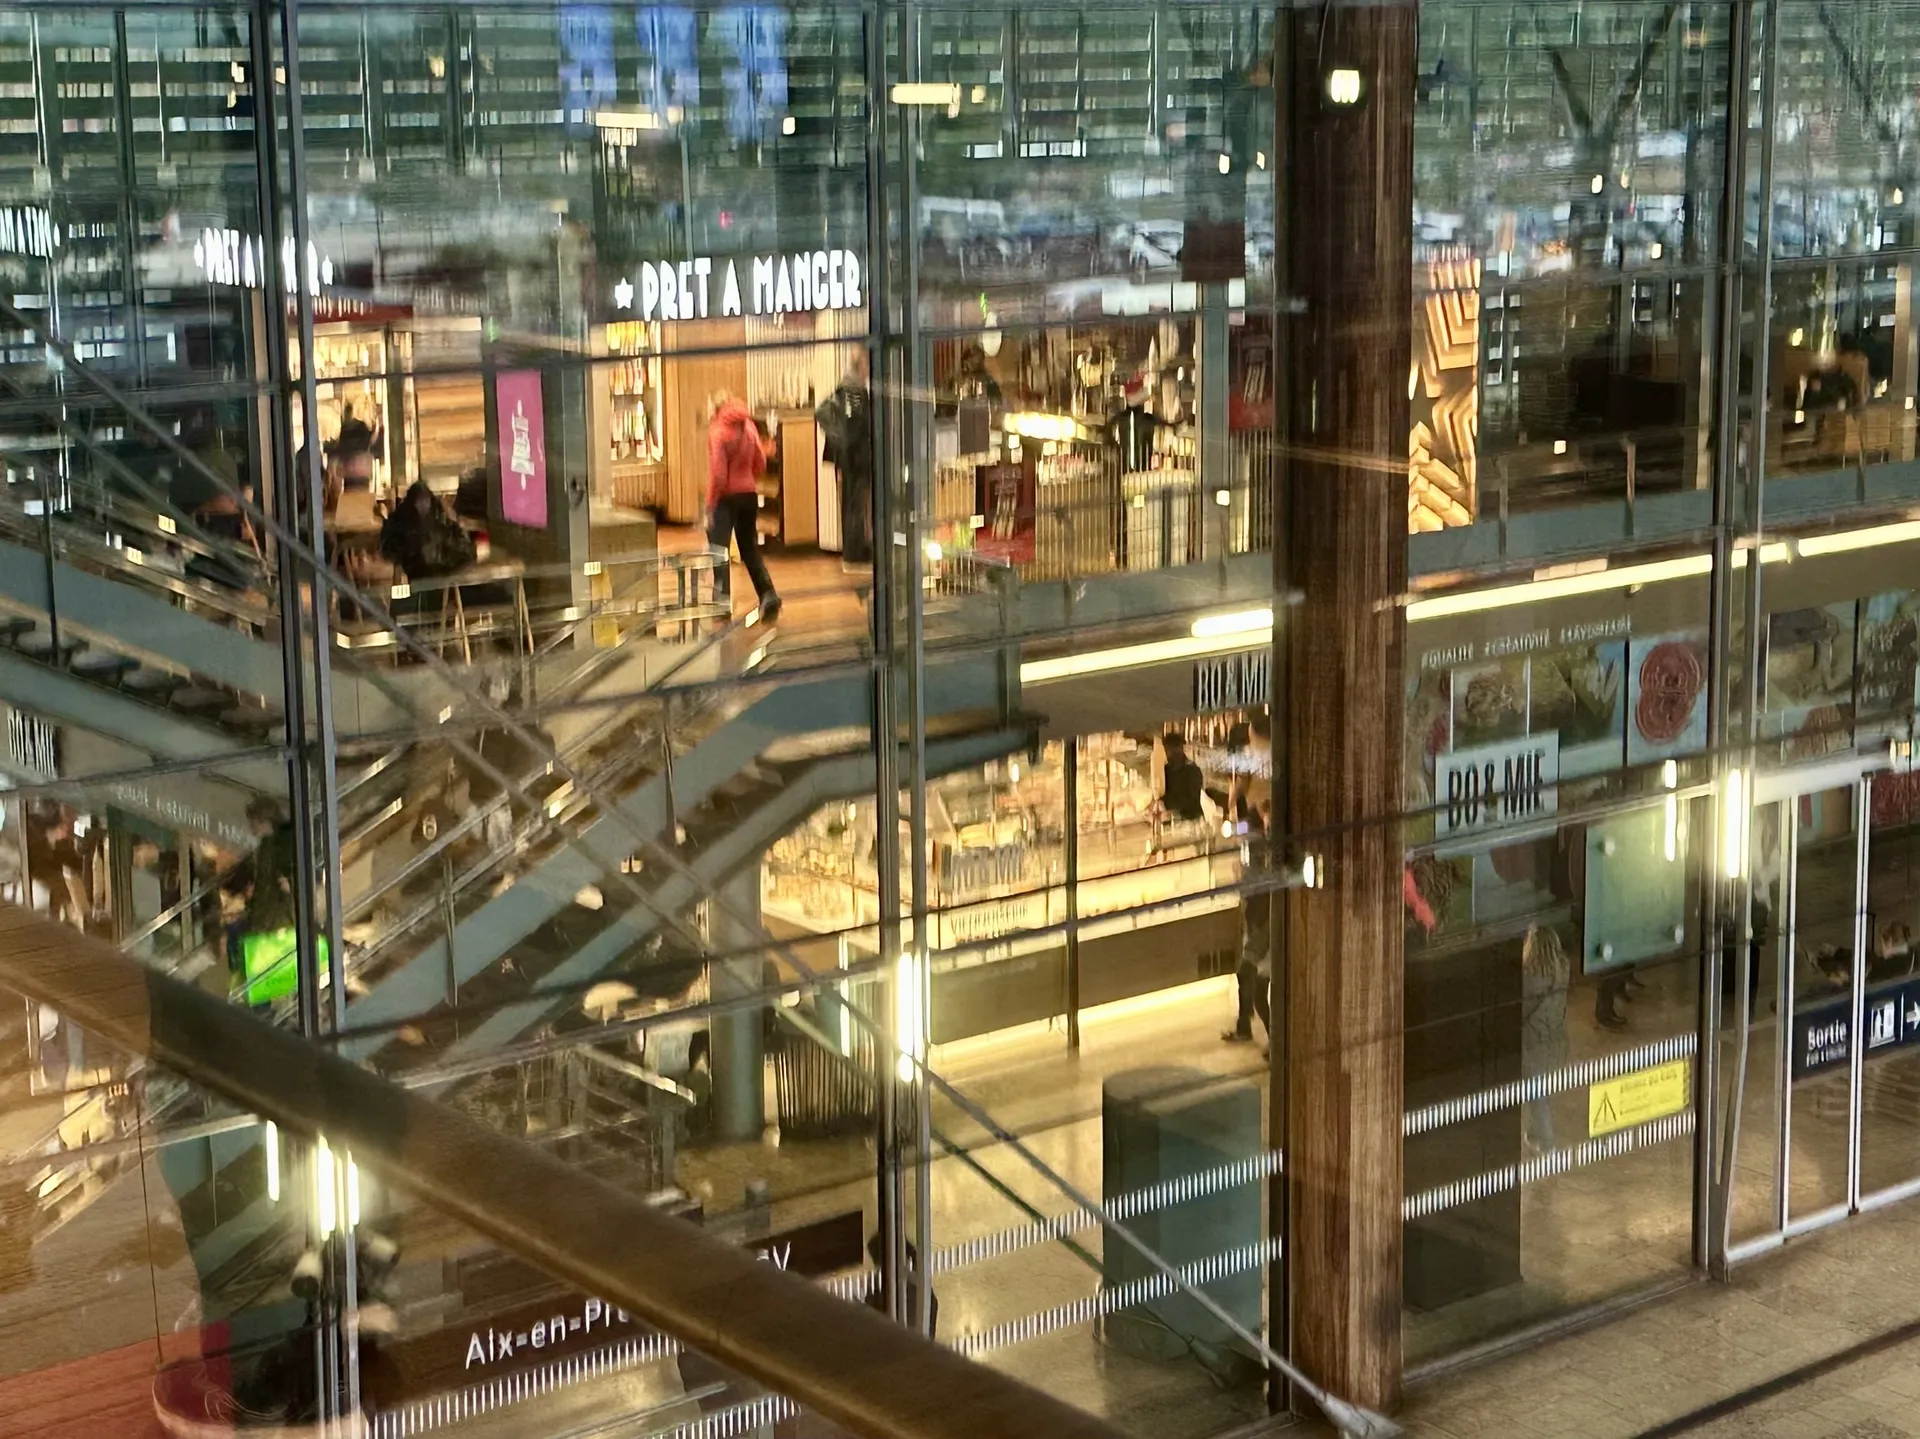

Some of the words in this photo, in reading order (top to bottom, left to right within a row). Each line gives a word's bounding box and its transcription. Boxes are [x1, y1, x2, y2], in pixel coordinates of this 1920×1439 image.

[642, 257, 712, 322] PRET
[722, 258, 741, 316] A
[753, 249, 861, 315] MANGER
